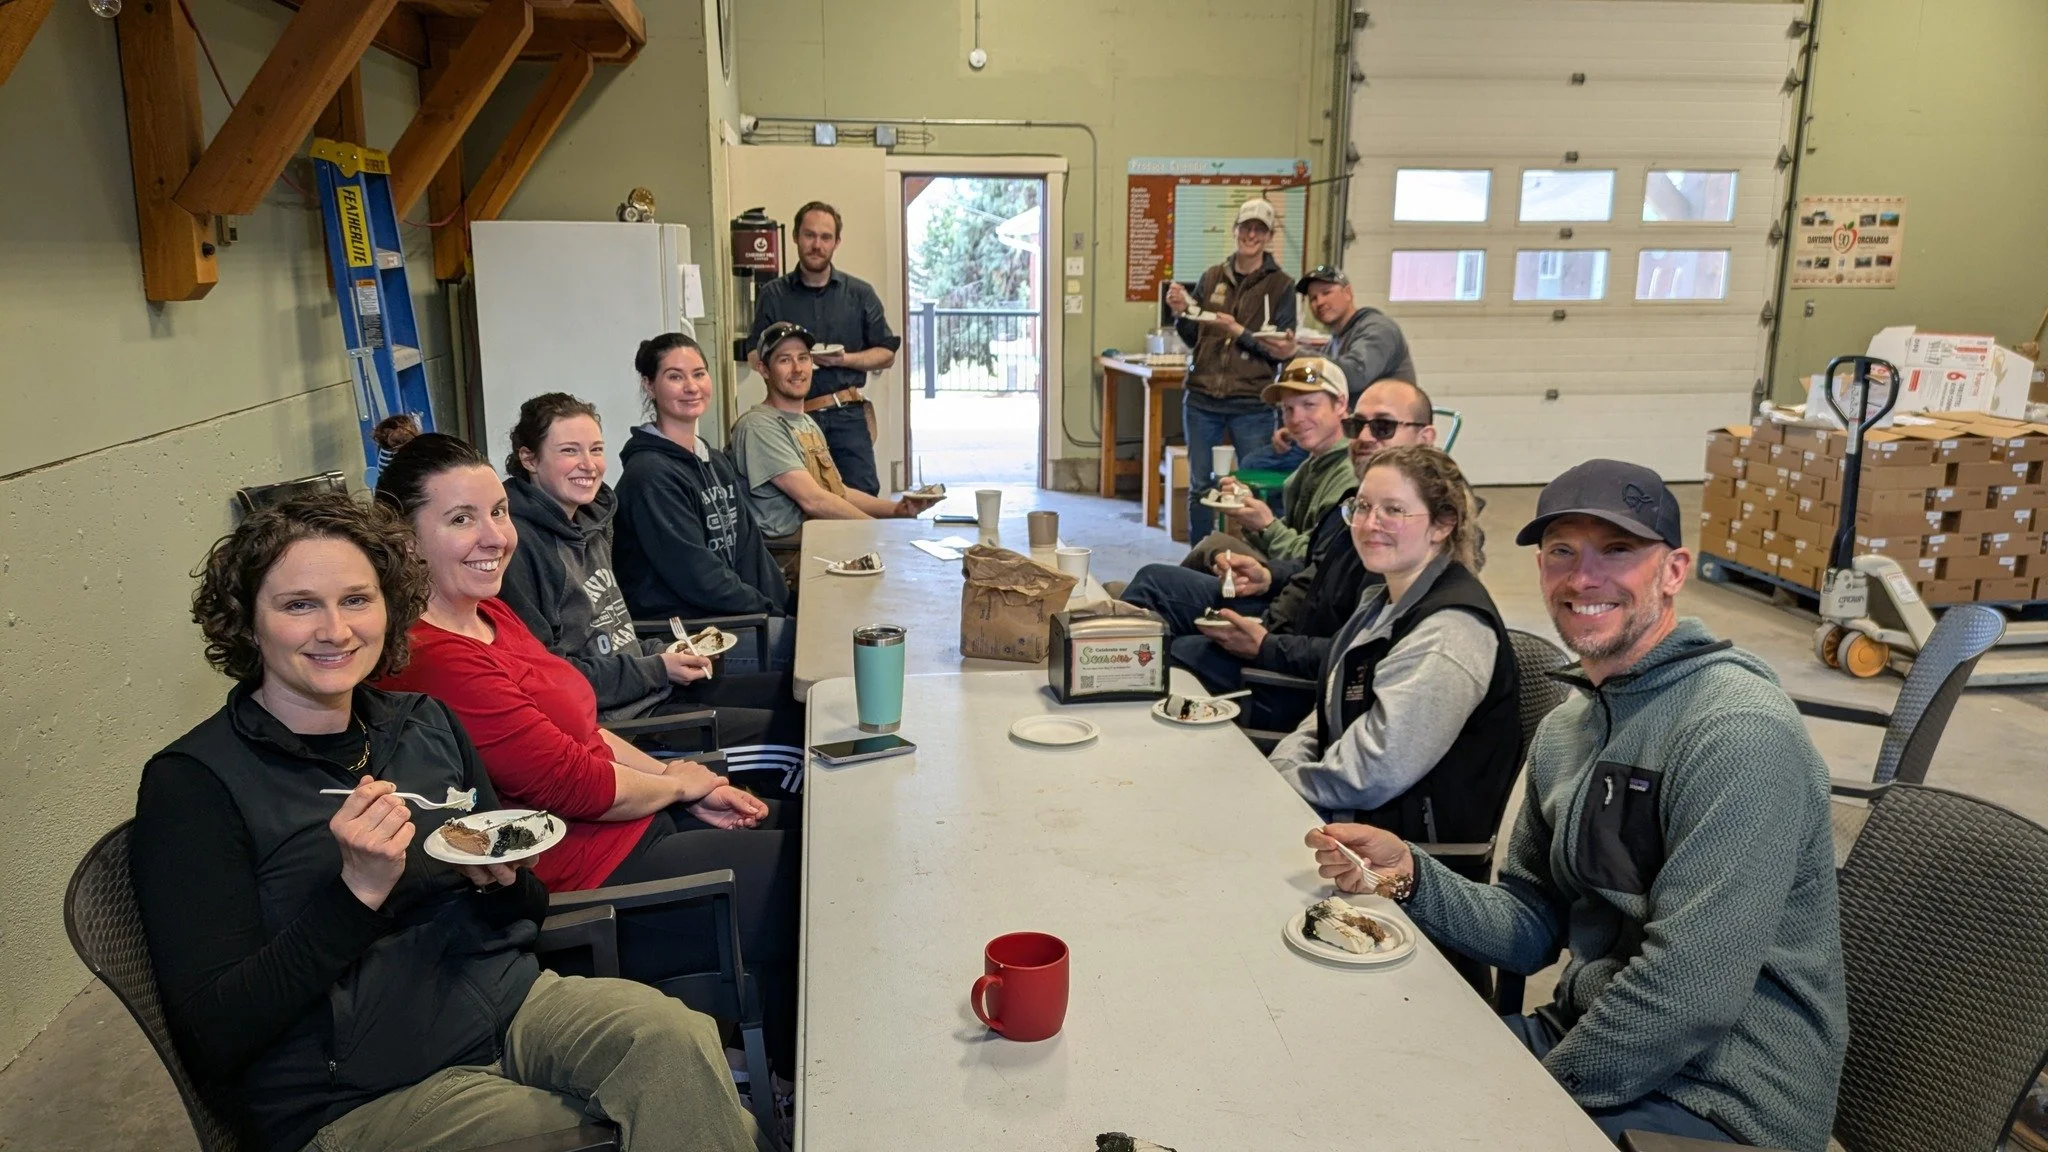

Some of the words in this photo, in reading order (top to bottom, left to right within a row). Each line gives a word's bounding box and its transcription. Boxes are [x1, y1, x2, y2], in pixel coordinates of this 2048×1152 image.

[343, 189, 367, 264] FEATHERLITE
[1857, 236, 1889, 244] ORCHARDS
[1838, 595, 1864, 604] CROWN
